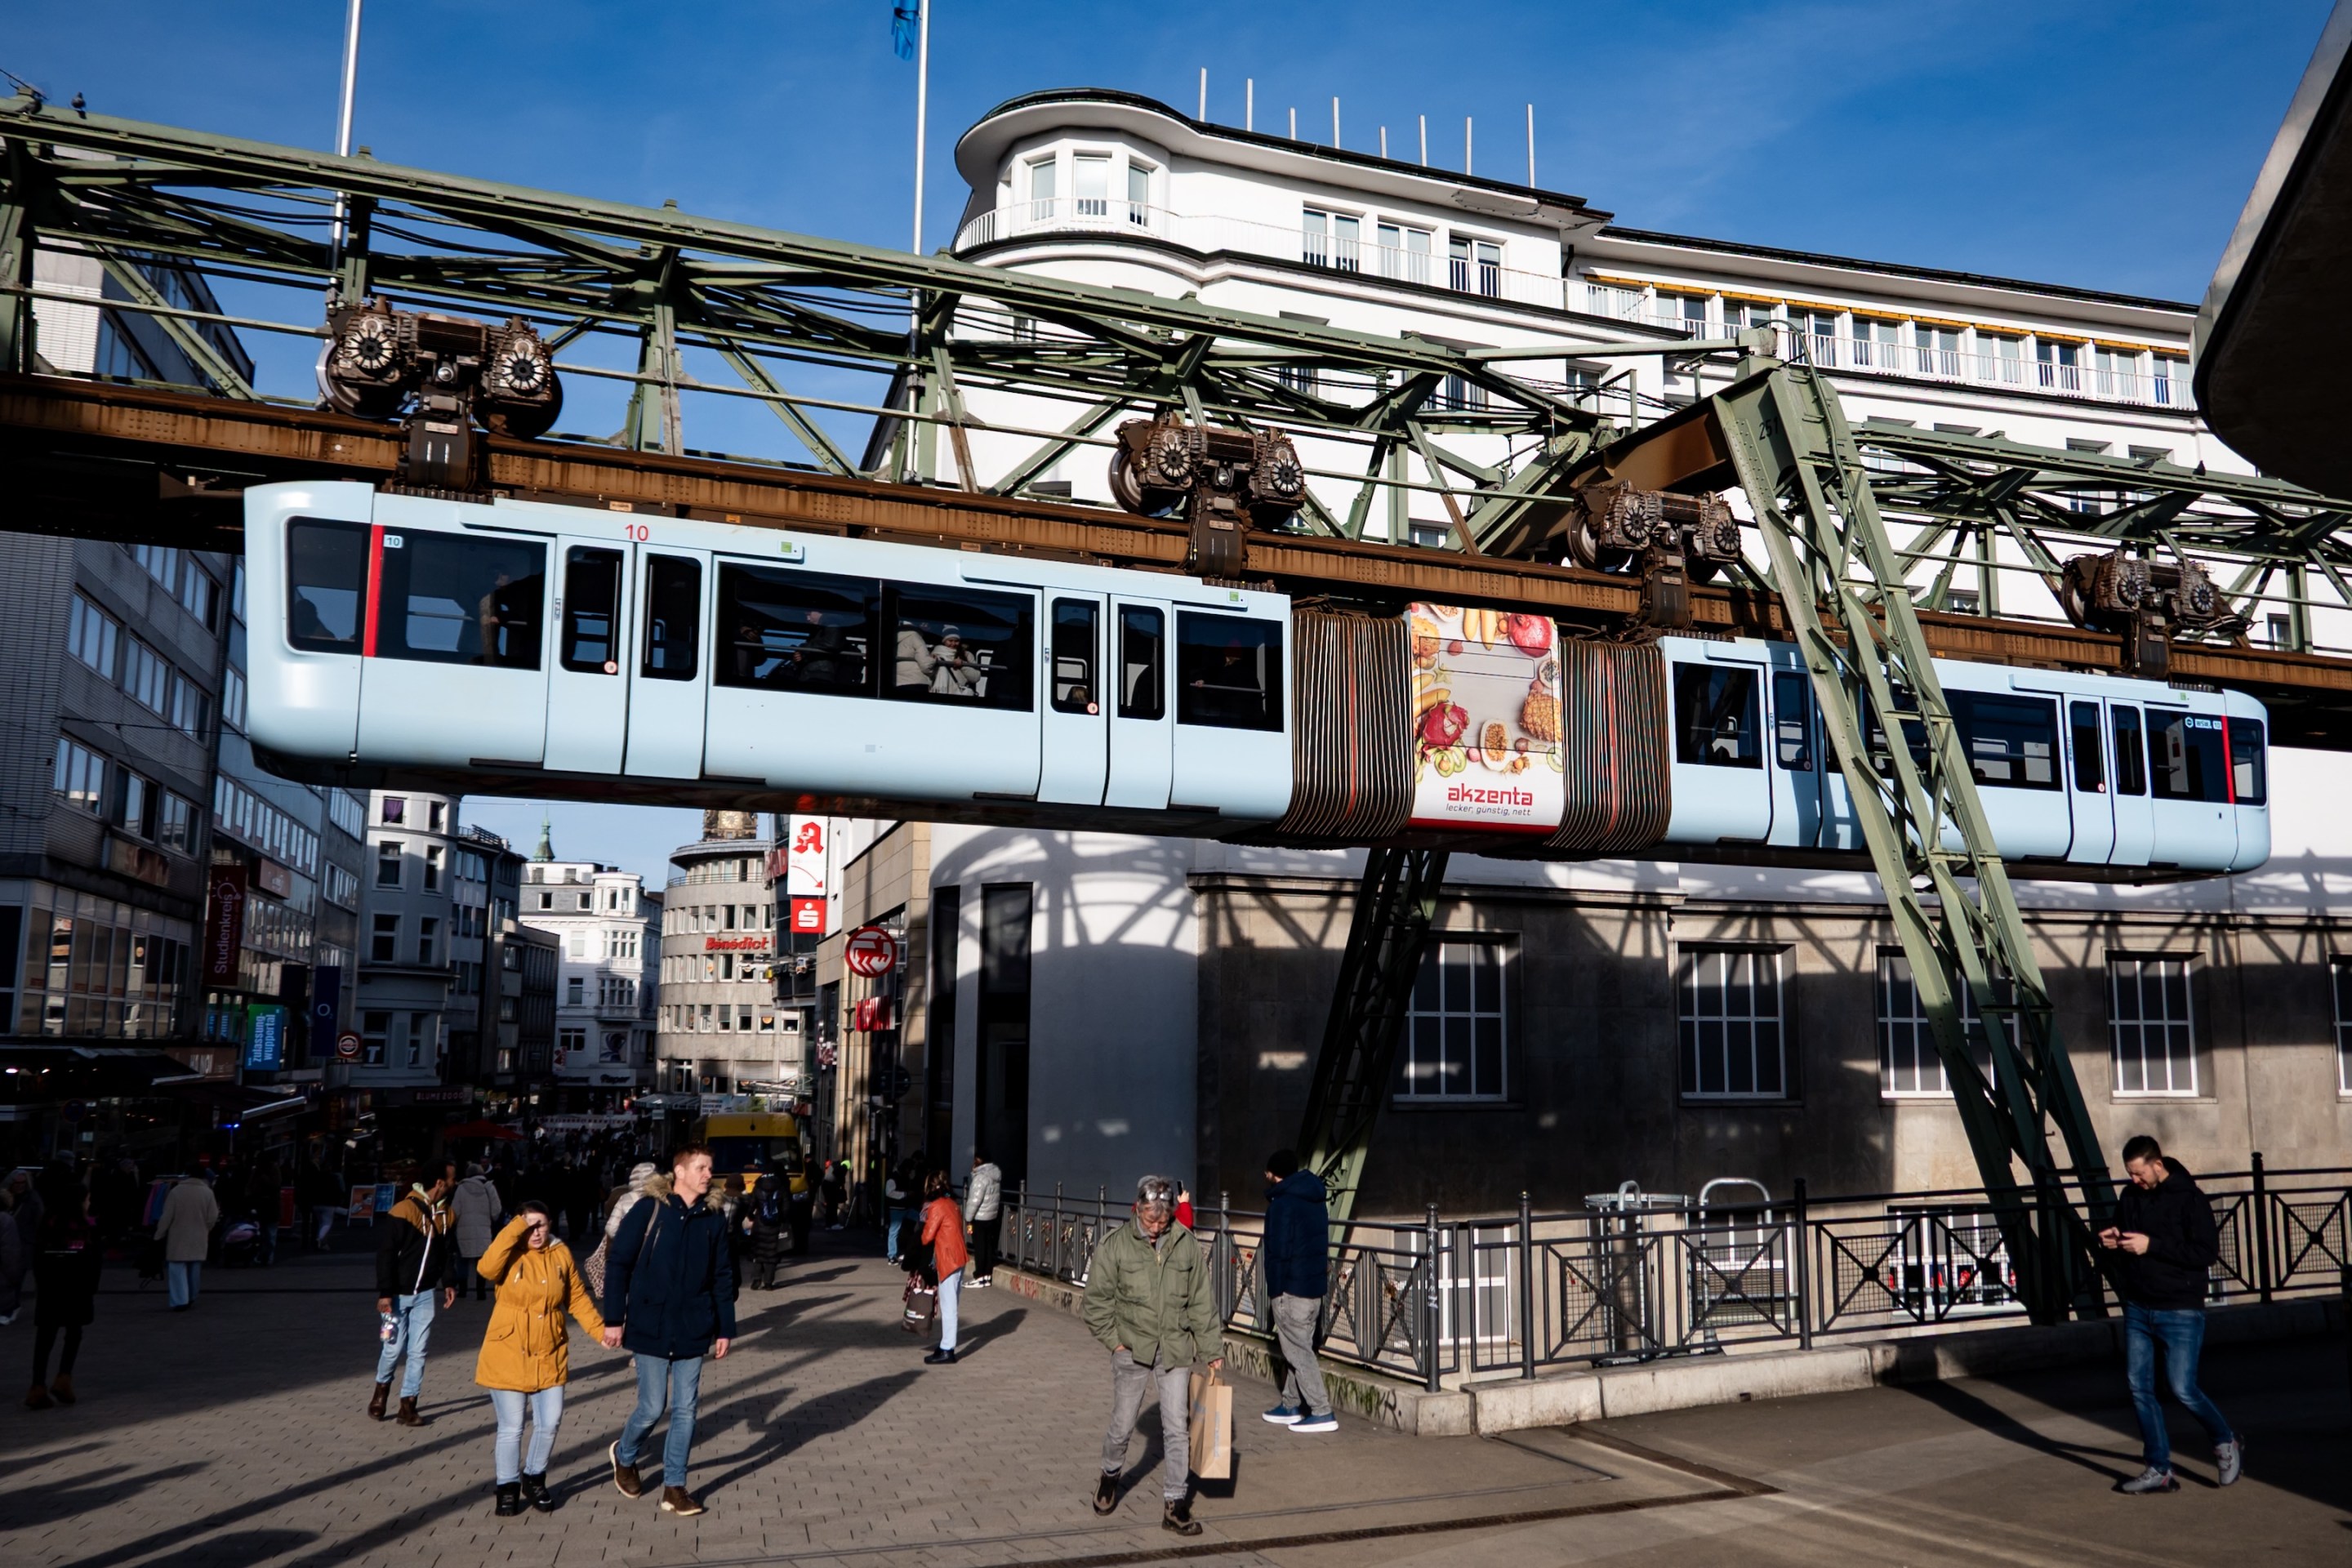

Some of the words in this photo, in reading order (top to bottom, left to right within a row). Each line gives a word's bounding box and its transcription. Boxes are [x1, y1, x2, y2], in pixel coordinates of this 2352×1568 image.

[1758, 416, 1779, 441] 251
[387, 537, 400, 546] 10
[625, 523, 648, 541] 10
[1447, 782, 1533, 806] akzenta
[1446, 803, 1474, 814] lecker,
[1476, 806, 1510, 817] günstig,
[214, 893, 234, 974] Studienkreis
[263, 1013, 276, 1061] wuppertal
